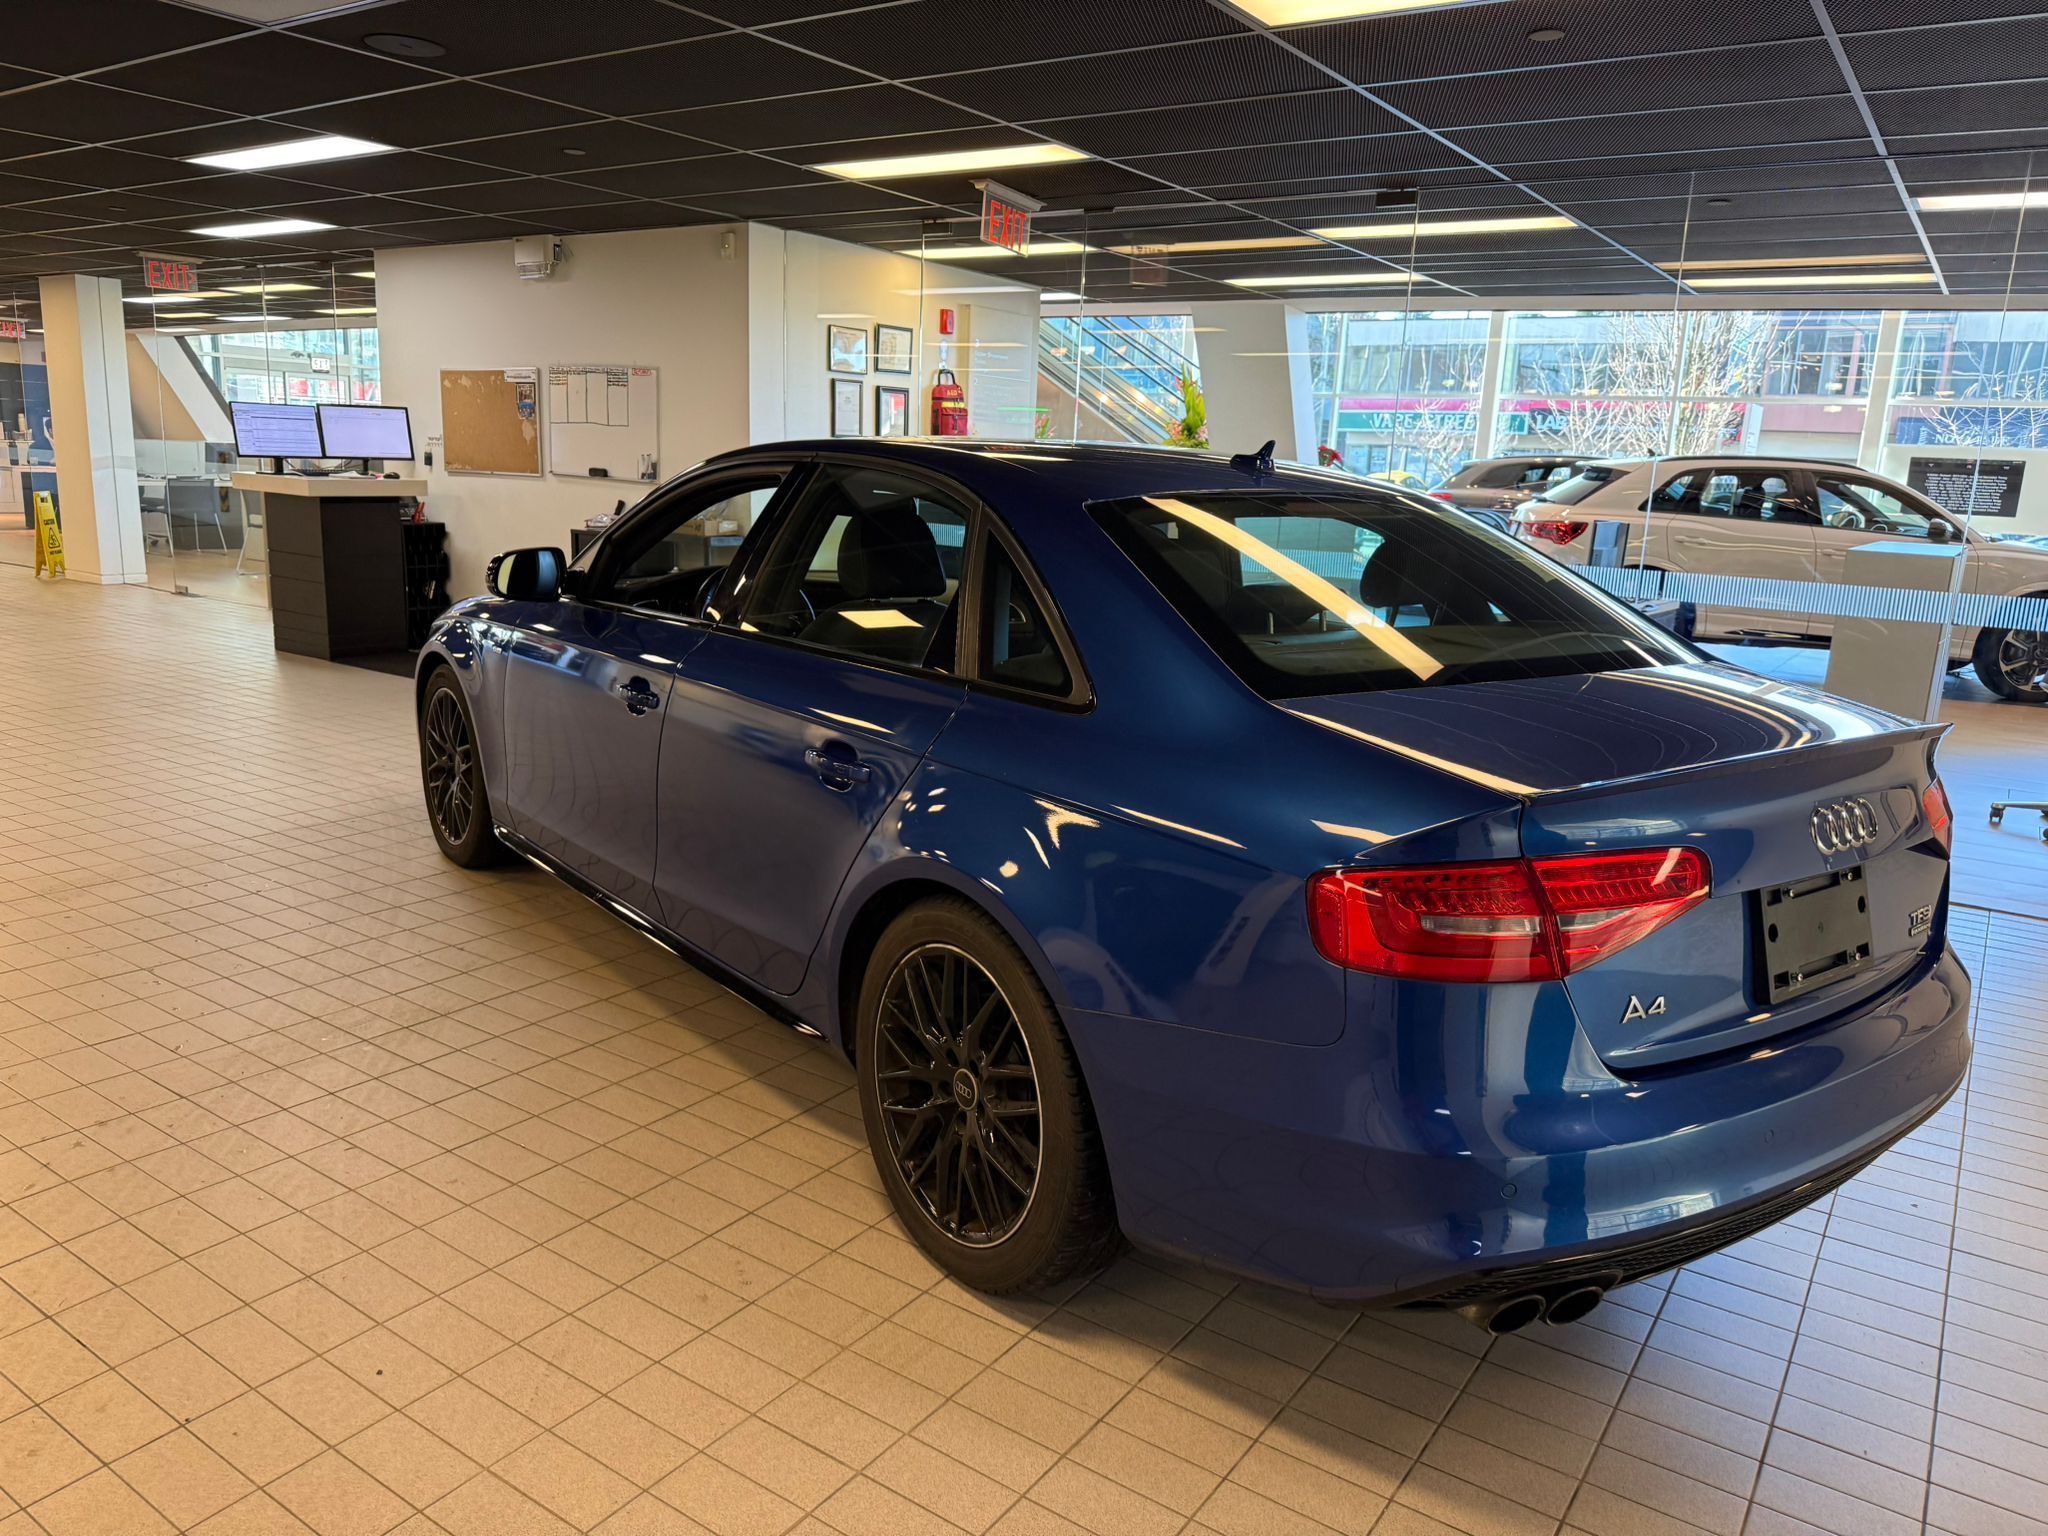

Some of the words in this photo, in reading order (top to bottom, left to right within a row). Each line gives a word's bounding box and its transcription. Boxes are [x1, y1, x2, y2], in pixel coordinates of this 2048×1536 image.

[989, 200, 1028, 254] EXIT
[149, 261, 189, 290] EXIT
[1372, 413, 1414, 428] VAPE
[1420, 413, 1476, 430] STREE
[1909, 904, 1932, 926] TFSI
[1620, 994, 1666, 1023] A4
